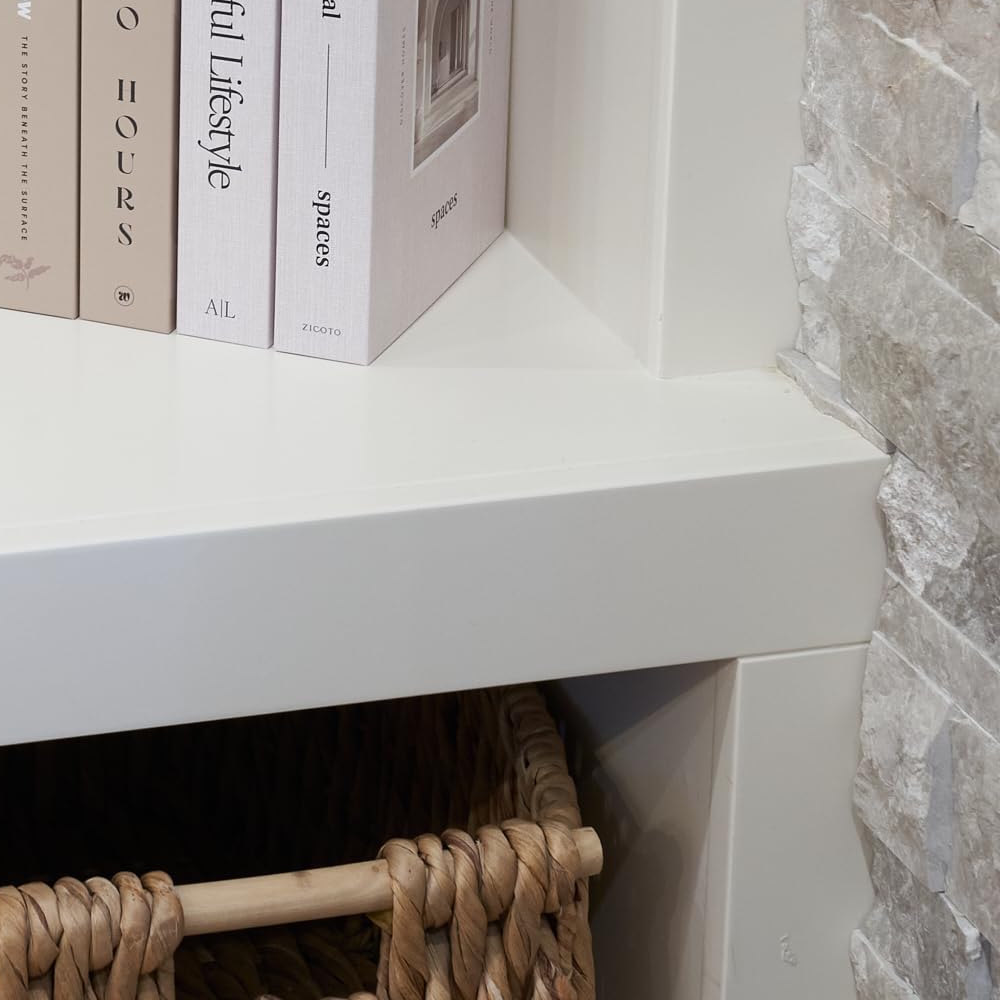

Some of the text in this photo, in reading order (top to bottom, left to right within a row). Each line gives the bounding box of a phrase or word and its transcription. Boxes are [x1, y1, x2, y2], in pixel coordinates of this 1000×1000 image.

[20, 36, 29, 241] THE STORY BENEATH THE SURFACE
[115, 78, 138, 246] HOURS
[197, 51, 244, 190] Lifestyle
[311, 190, 331, 267] spaces
[430, 192, 458, 230] spaces
[301, 323, 342, 337] ZICOTO
